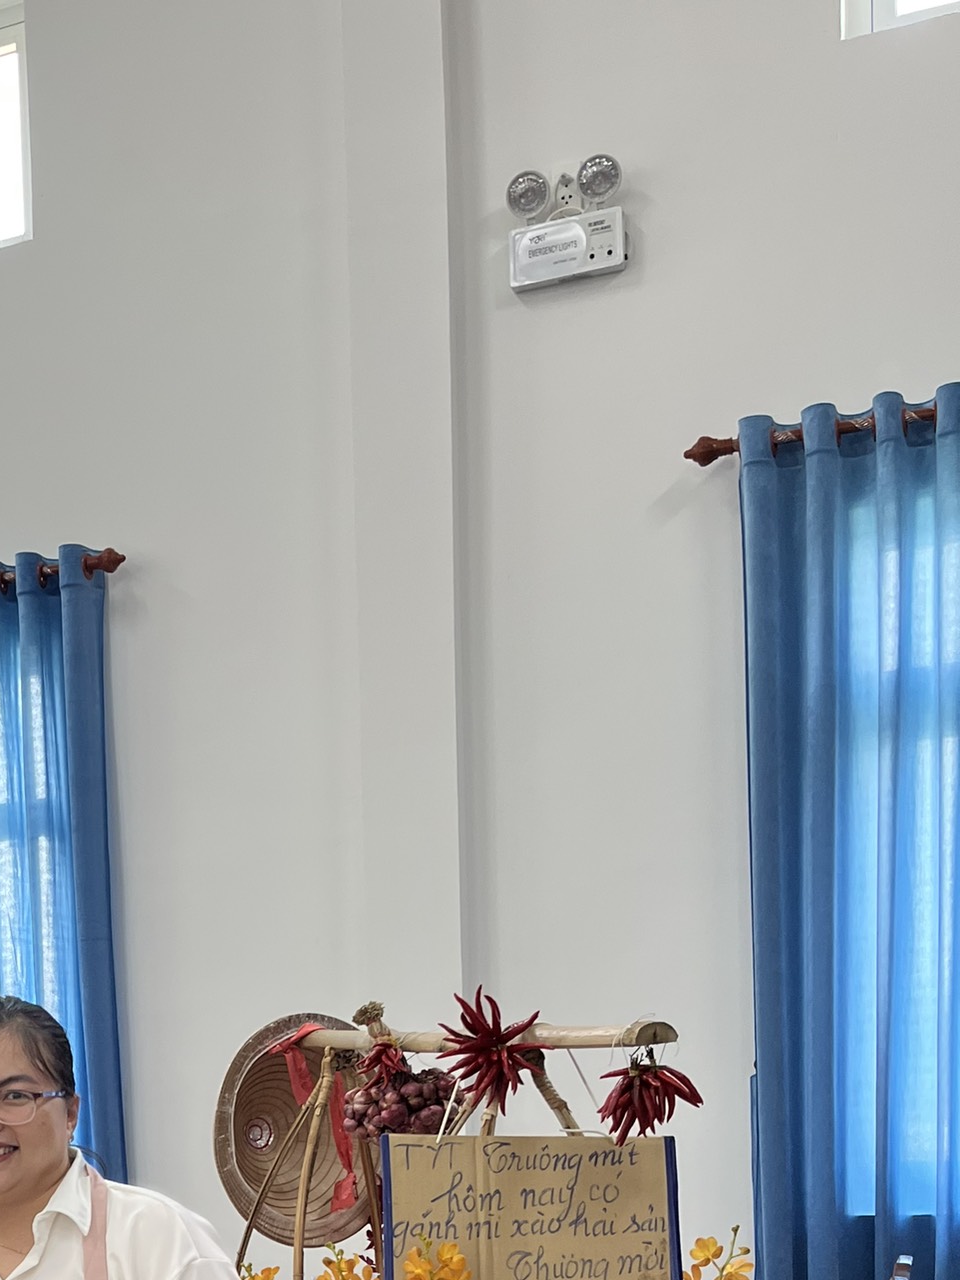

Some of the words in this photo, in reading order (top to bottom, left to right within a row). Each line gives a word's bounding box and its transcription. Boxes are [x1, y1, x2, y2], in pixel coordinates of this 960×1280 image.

[431, 1171, 505, 1213] hôm
[520, 1186, 574, 1223] nay
[589, 1170, 623, 1204] có
[393, 1210, 460, 1258] gánh
[510, 1211, 562, 1238] xào
[568, 1201, 617, 1237] hải
[622, 1204, 668, 1234] sản
